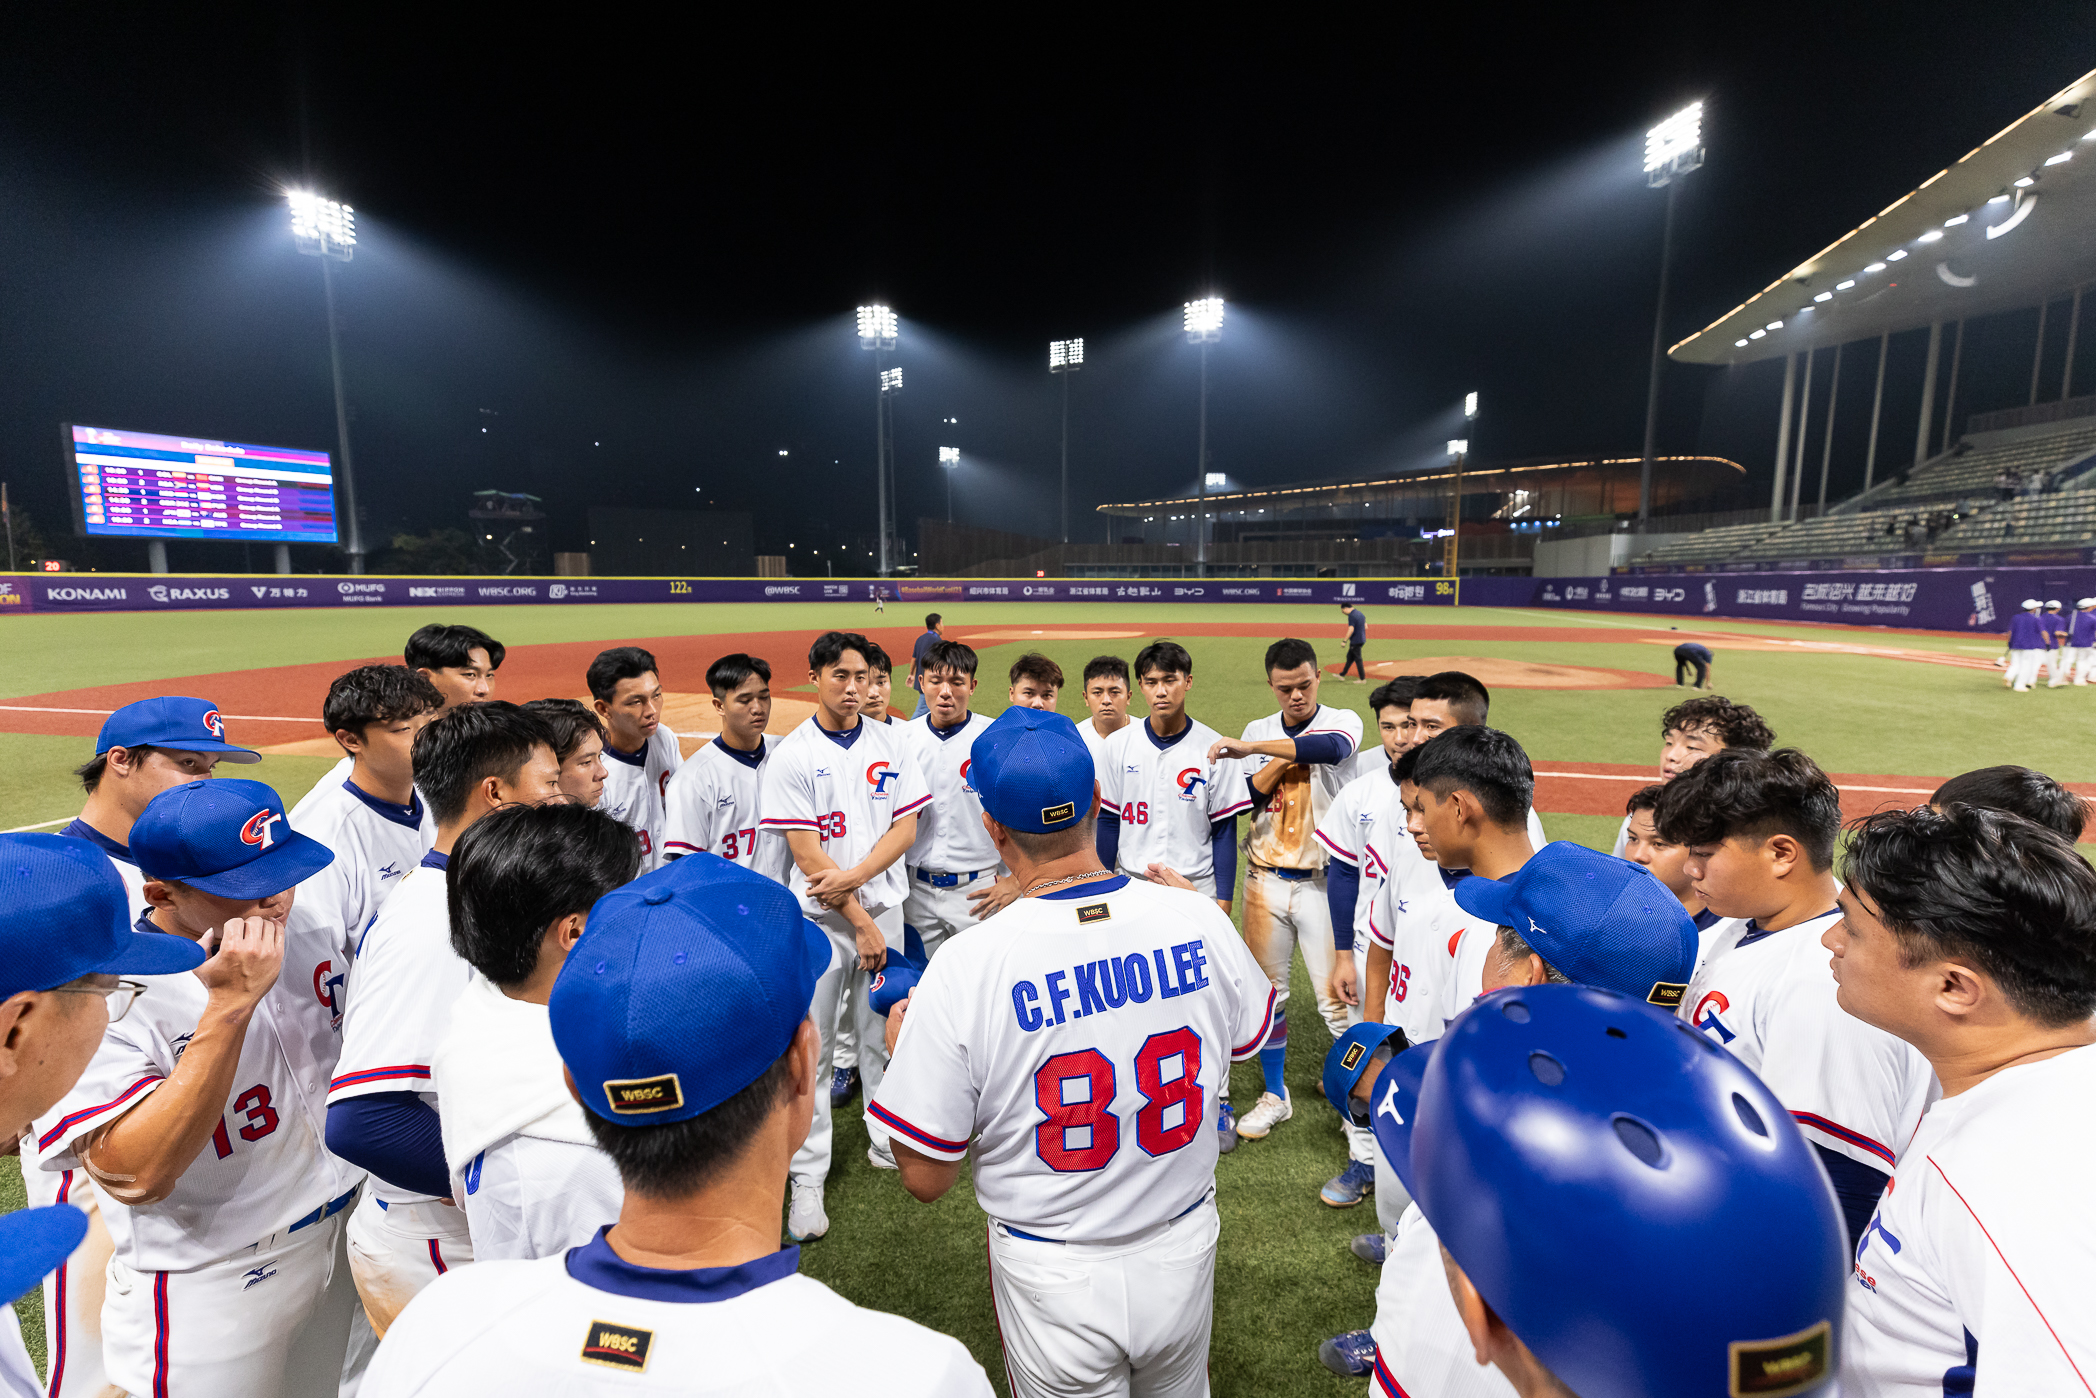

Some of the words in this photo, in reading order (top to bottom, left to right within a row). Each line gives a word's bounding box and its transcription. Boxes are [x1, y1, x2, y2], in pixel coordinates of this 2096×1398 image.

[45, 561, 60, 571] 20
[47, 588, 127, 600] KONAMI
[170, 588, 230, 600] RAXUS
[354, 584, 386, 592] MUFG
[478, 587, 537, 596] WBSC.ORG
[765, 586, 800, 596] @WBSC
[1174, 588, 1205, 596] BYD
[1222, 588, 1260, 596] WBSC.ORG
[1653, 588, 1685, 601] BYD
[1049, 808, 1069, 818] WBSC
[1121, 801, 1149, 825] 46
[816, 811, 847, 842] 53
[722, 827, 756, 860] 37
[1083, 907, 1104, 917] WBSC
[1011, 952, 1154, 1032] C.F.KUO
[1152, 940, 1210, 1000] LEE
[1660, 988, 1681, 998] WBSC
[1346, 1048, 1359, 1063] WBSC
[620, 1085, 664, 1103] WBSC
[1034, 1025, 1205, 1173] 88
[598, 1330, 639, 1354] WBSC
